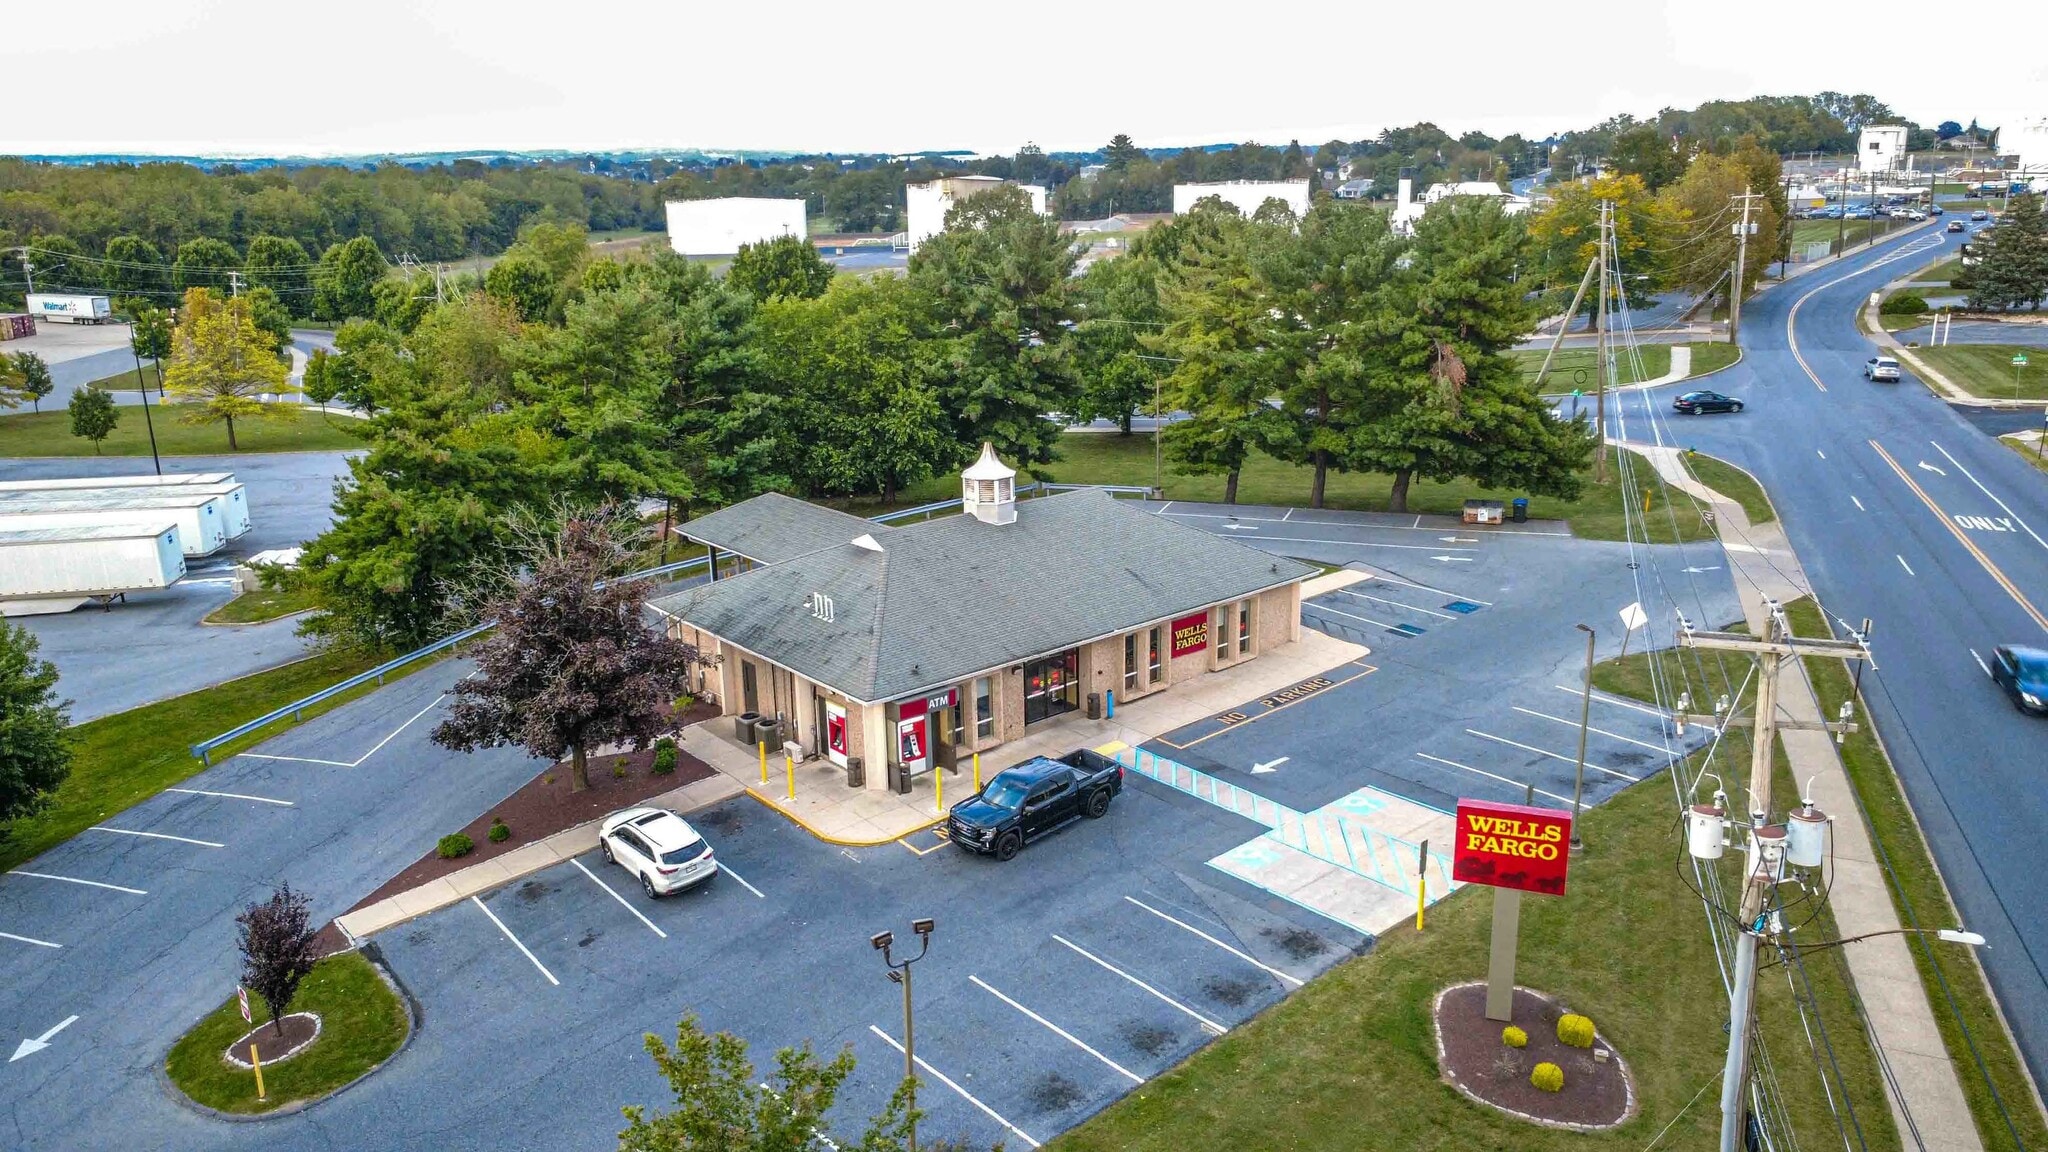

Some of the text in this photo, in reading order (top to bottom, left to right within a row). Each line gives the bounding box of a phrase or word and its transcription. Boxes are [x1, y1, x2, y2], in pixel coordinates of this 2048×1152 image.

[43, 301, 68, 311] Walmart
[1954, 515, 2017, 532] ONLY
[1175, 622, 1207, 640] WELLS
[1176, 633, 1207, 650] FARGO
[928, 695, 948, 709] ATM
[1216, 678, 1332, 725] NO PARKING
[1466, 814, 1562, 842] WELLS
[1466, 833, 1558, 861] FARGO
